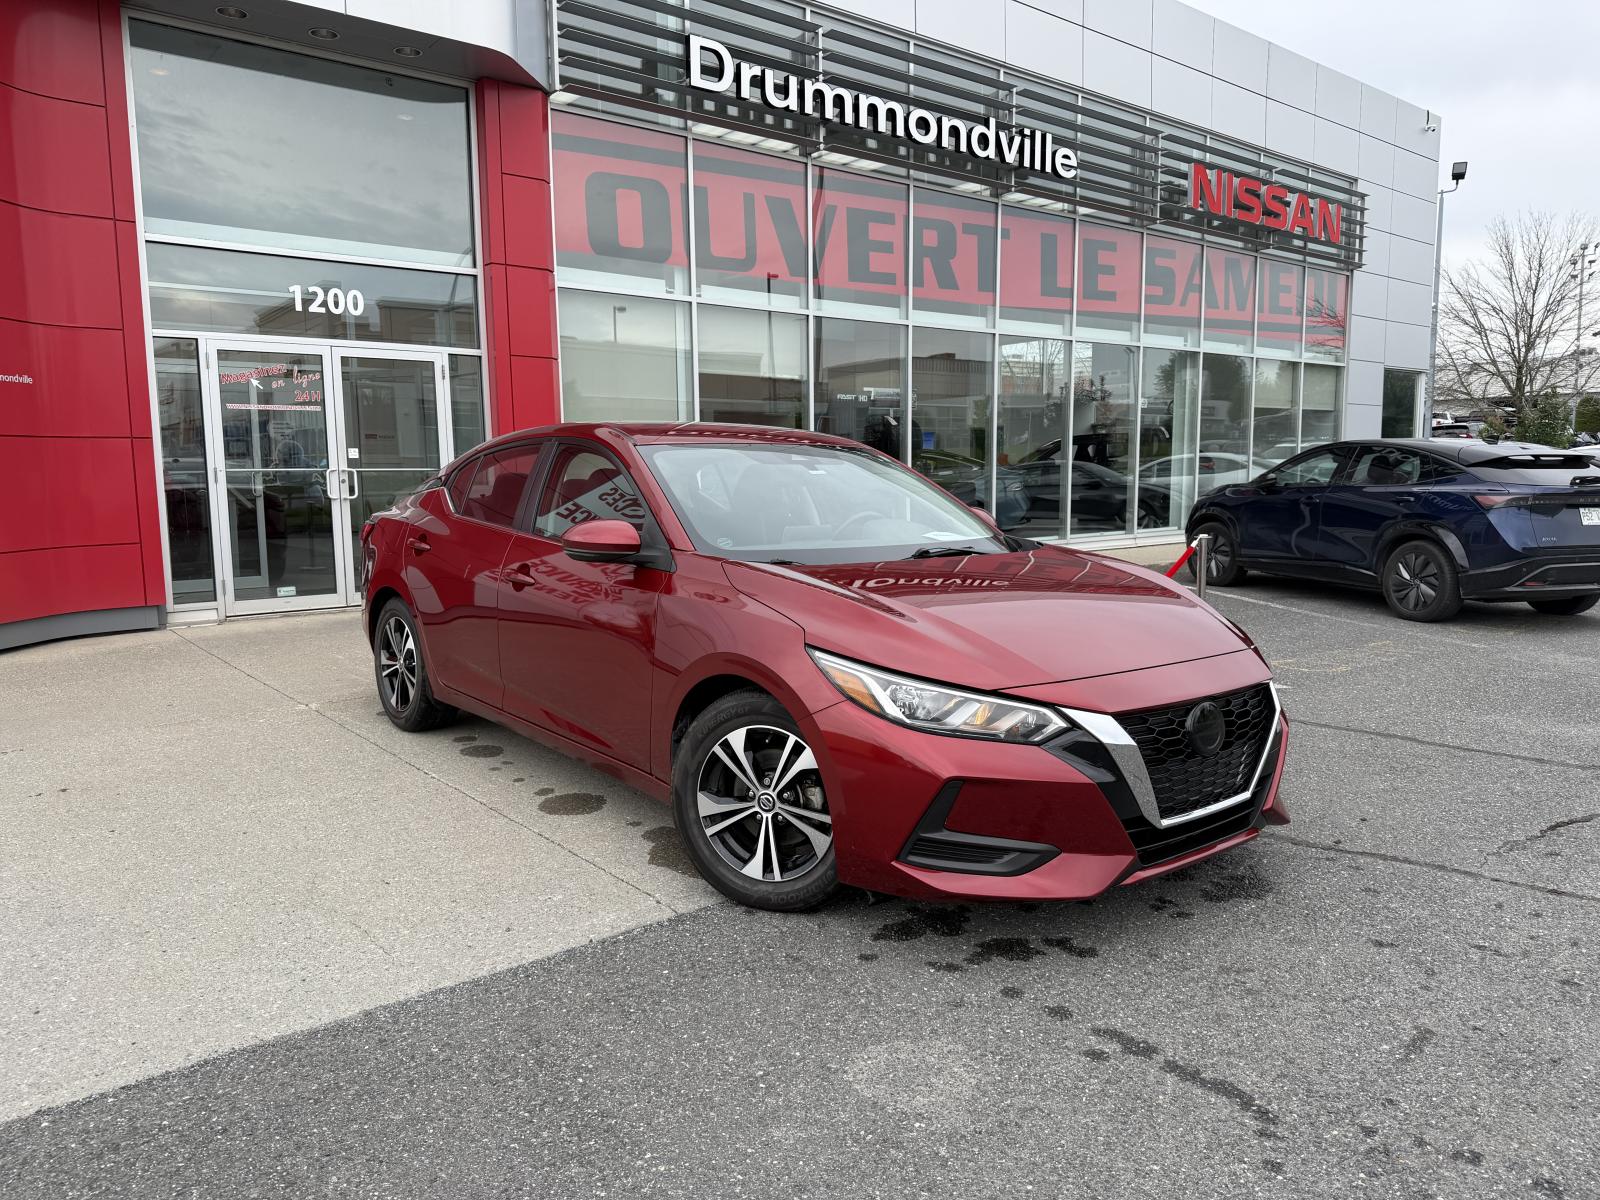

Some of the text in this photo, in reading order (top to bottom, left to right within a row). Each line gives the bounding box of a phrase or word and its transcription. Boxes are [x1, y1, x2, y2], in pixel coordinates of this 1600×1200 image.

[686, 34, 1078, 179] Drummondville
[1188, 162, 1342, 244] NISSAN
[585, 171, 1338, 318] OUVERT LE SAMEDI
[288, 284, 365, 316] 1200
[220, 363, 288, 385] Magasinez
[292, 364, 321, 388] ligne
[294, 390, 309, 402] 24
